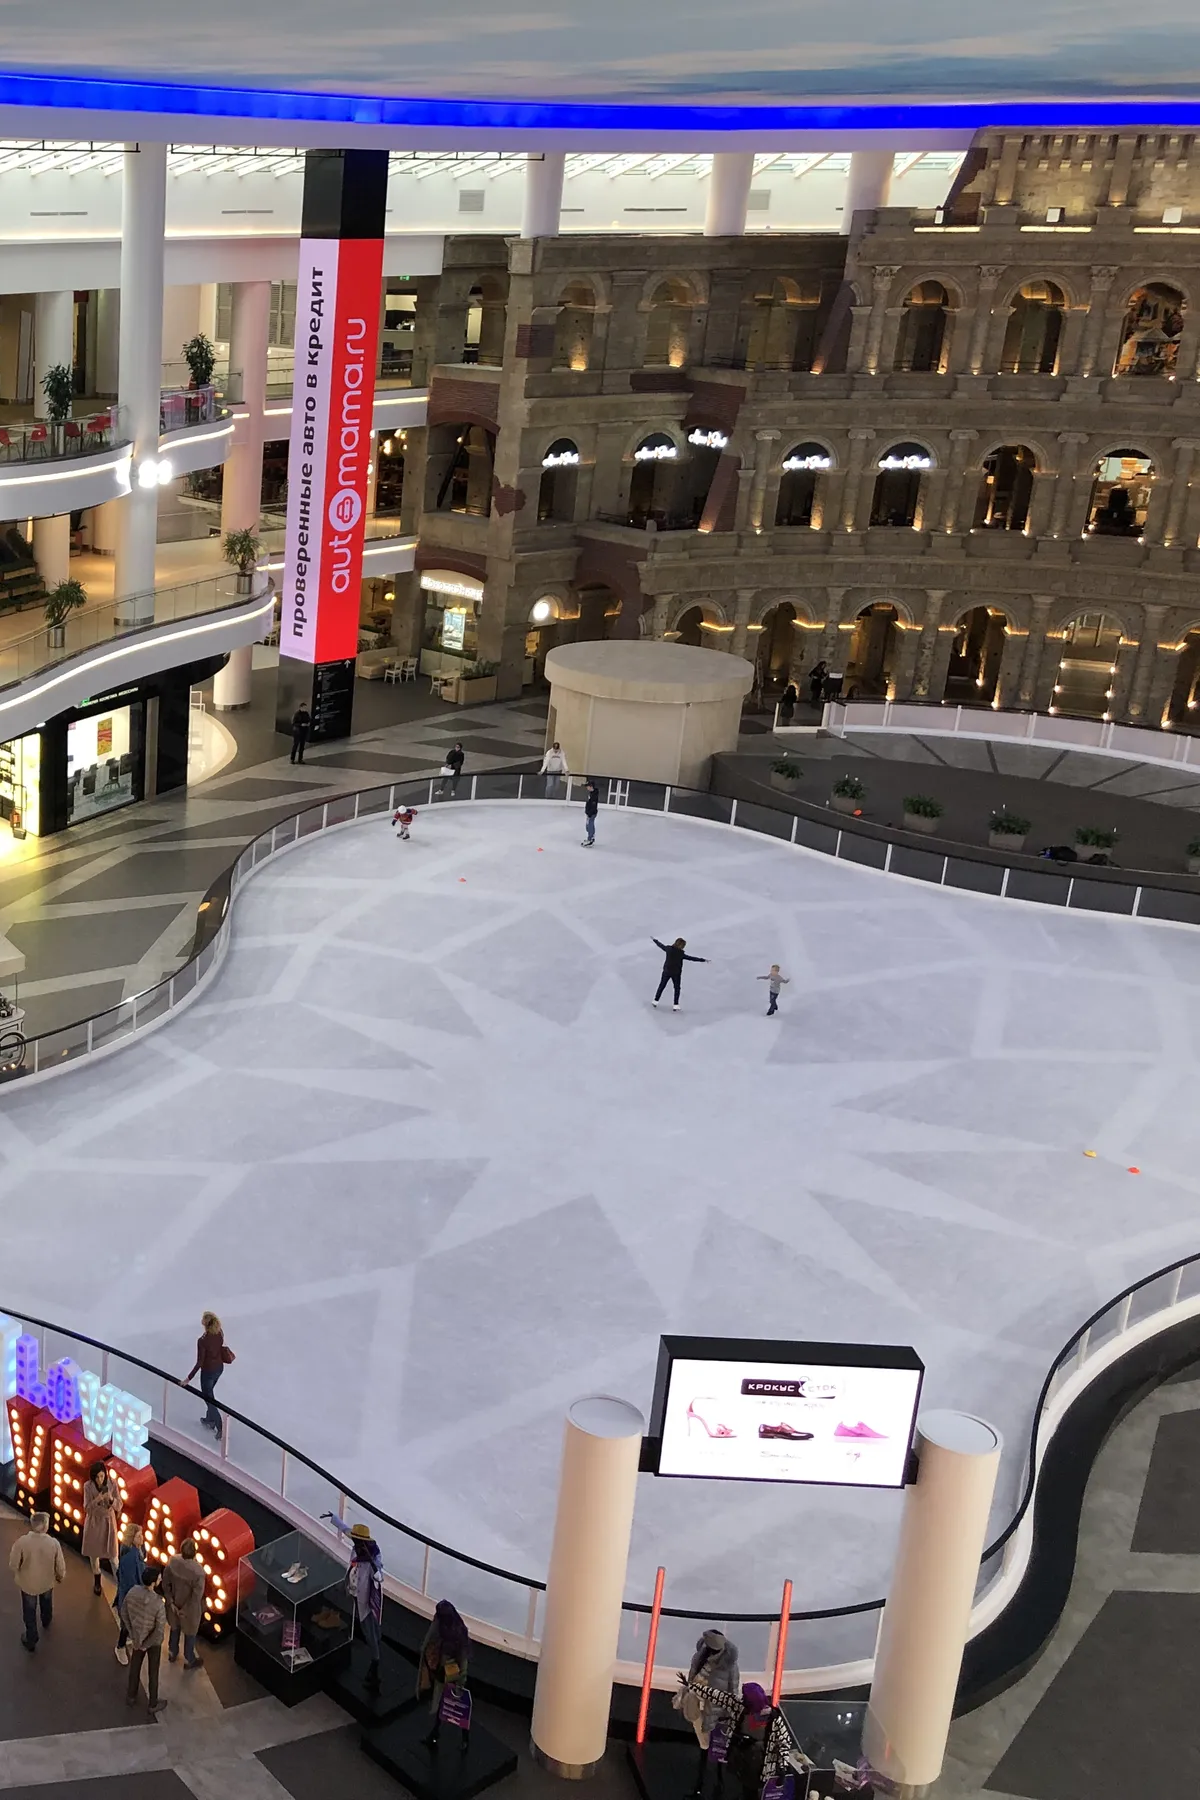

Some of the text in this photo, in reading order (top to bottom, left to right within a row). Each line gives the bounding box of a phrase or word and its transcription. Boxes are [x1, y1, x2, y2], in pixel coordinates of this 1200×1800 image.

[293, 267, 324, 637] проверенные авто в кредит
[16, 1333, 152, 1470] LOVE
[748, 1383, 796, 1392] КРОКУС
